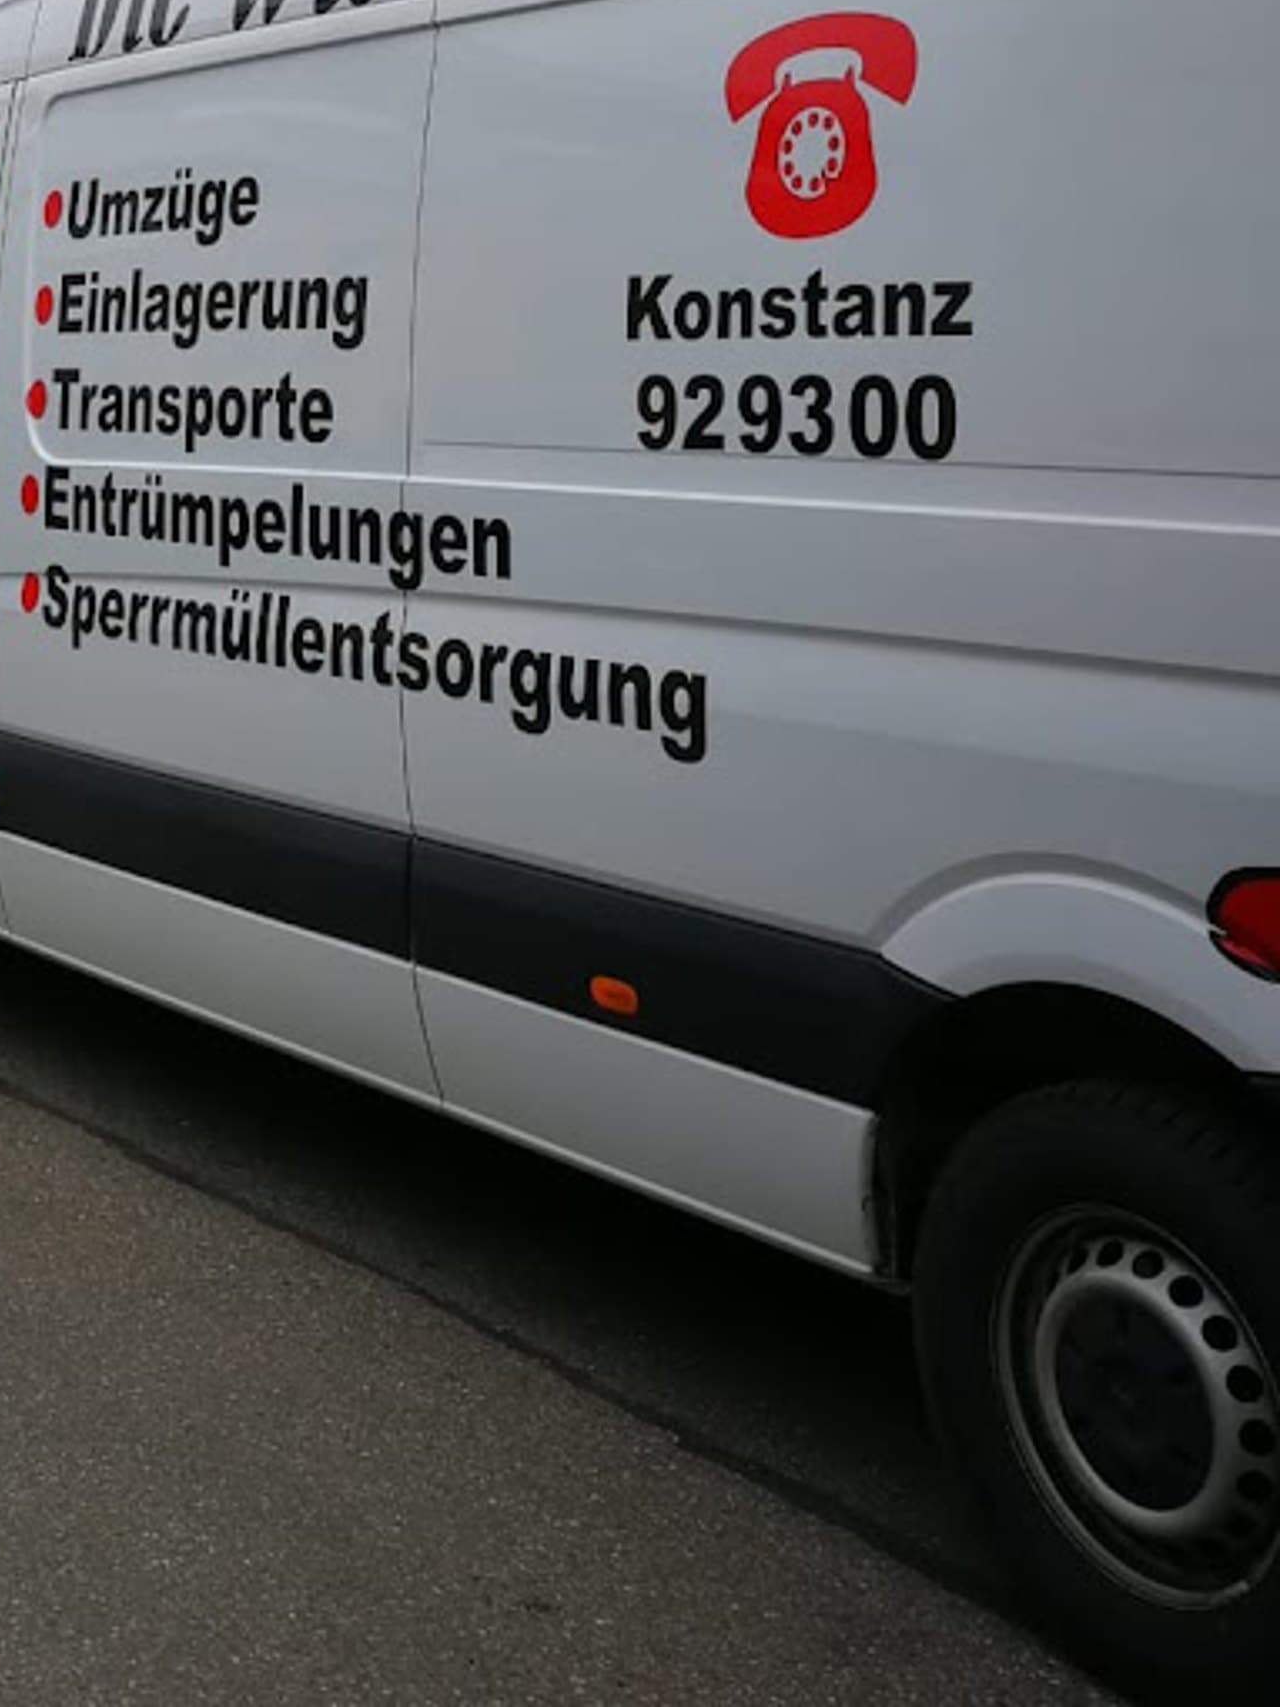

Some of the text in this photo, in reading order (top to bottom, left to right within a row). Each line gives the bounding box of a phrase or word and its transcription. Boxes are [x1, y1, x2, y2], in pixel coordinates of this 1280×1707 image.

[67, 169, 260, 245] Umzüge
[56, 269, 369, 351] Einlagerung
[625, 268, 974, 342] Konstanz
[51, 367, 335, 453] Transporte
[636, 373, 958, 463] 929300
[43, 464, 512, 592] Entrümpelungen
[41, 564, 708, 765] Sperrmüllentsorgung
